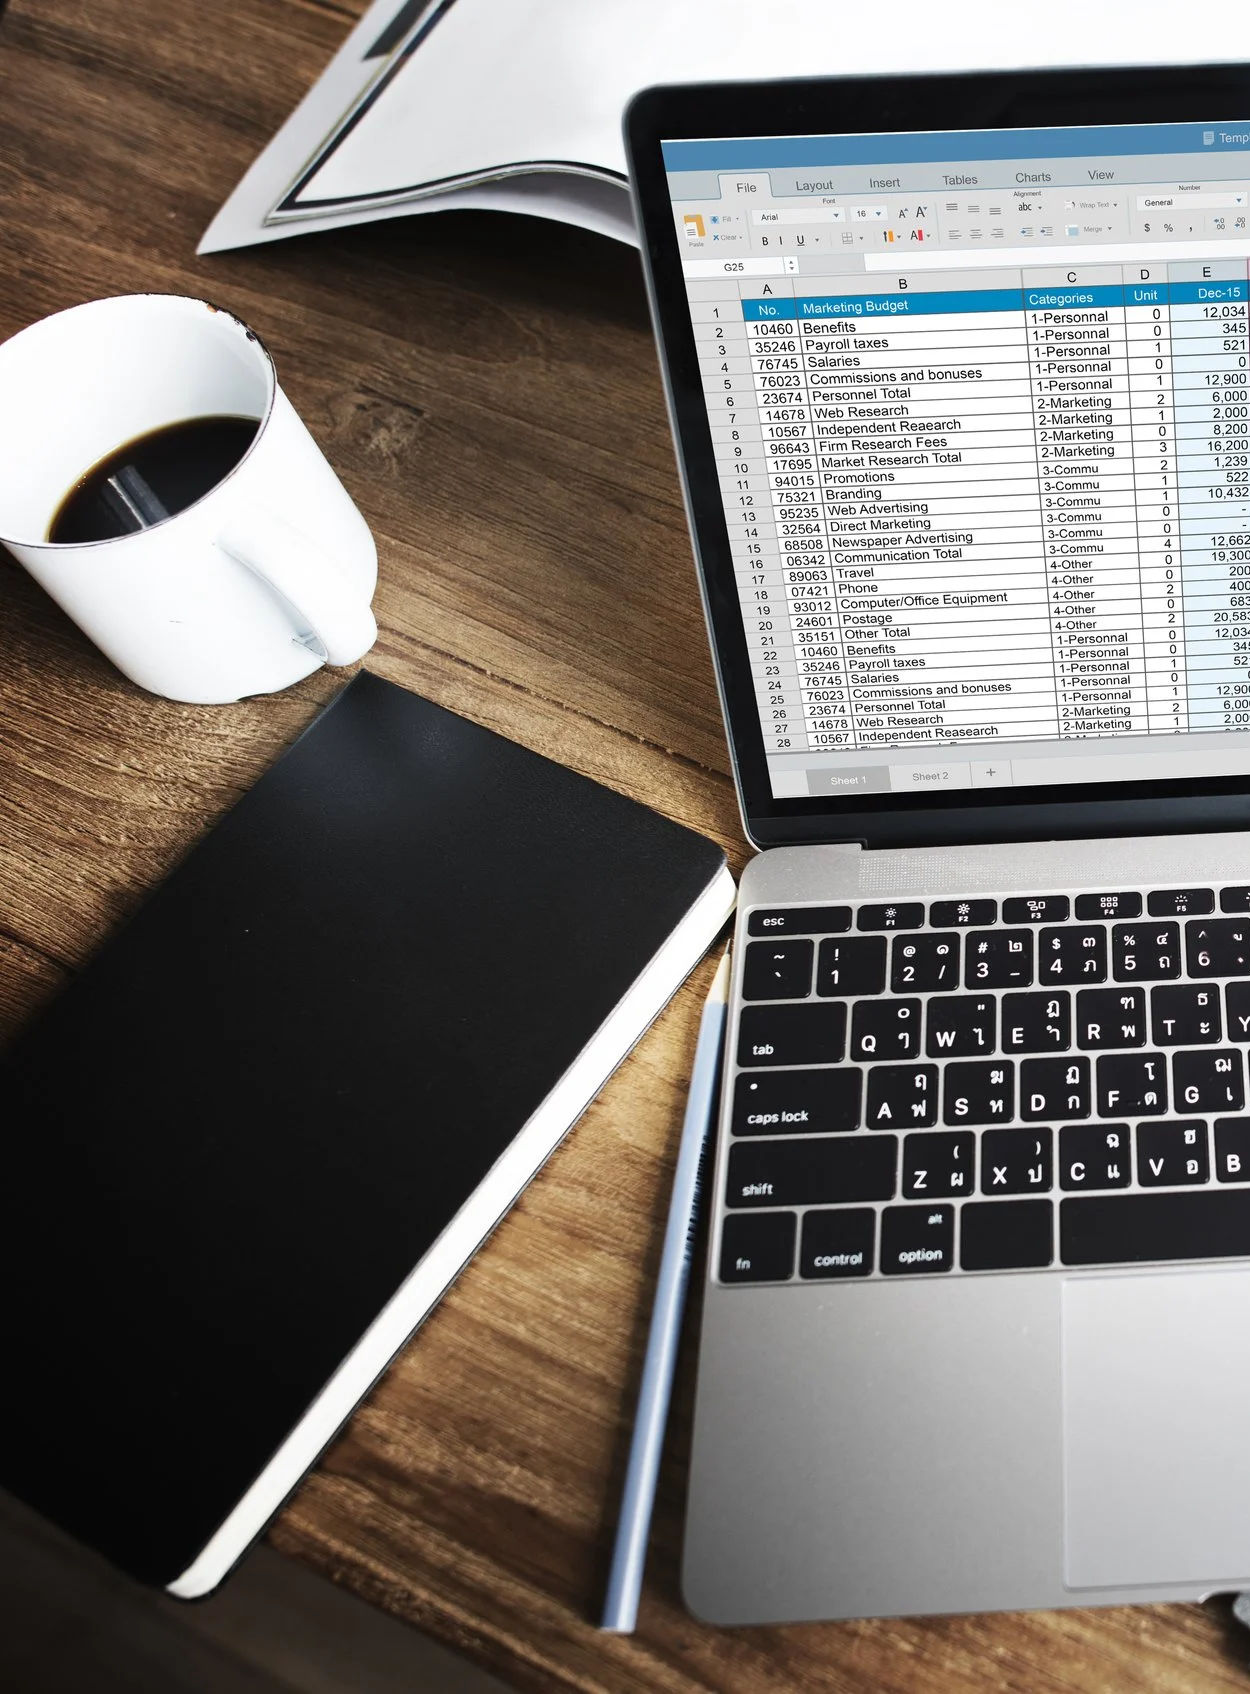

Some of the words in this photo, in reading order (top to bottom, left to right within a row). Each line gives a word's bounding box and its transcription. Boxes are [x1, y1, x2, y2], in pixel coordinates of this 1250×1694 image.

[943, 174, 978, 185] Tables
[1015, 172, 1051, 183] Charts
[1088, 170, 1114, 180] View
[737, 183, 757, 193] File
[796, 181, 833, 192] Layout
[869, 178, 900, 188] Insert
[1013, 190, 1041, 198] Alignment
[1018, 202, 1032, 212] abc
[1145, 199, 1173, 207] General
[761, 213, 778, 221] Arial
[857, 210, 866, 218] 16
[1083, 225, 1102, 234] Merge
[724, 263, 744, 272] G25
[1203, 267, 1211, 278] E
[1067, 271, 1077, 283] C
[763, 284, 772, 294] A
[899, 279, 908, 289] B
[1029, 292, 1094, 306] Categories
[1134, 289, 1158, 301] Unit
[1198, 287, 1240, 299] Dec-15
[758, 306, 780, 316] No.
[803, 302, 862, 314] Marketing
[866, 300, 908, 313] Budget
[1203, 305, 1246, 320] 12,034
[1032, 310, 1108, 325] 1-Personnal
[1153, 308, 1160, 320] 0
[754, 324, 793, 336] 10460
[804, 322, 856, 334] Benefits
[755, 341, 796, 353] 35246
[806, 339, 850, 354] Payroll
[854, 338, 889, 349] taxes
[758, 358, 798, 370] 76745
[808, 356, 860, 368] Salaries
[760, 376, 800, 388] 76023
[810, 371, 896, 386] Commissions
[900, 370, 925, 382] and
[928, 368, 982, 380] bonuses
[812, 389, 877, 402] Personnel
[881, 388, 911, 399] Total
[1037, 395, 1112, 411] 2-Marketing
[814, 408, 844, 419] Web
[848, 405, 909, 418] Research
[768, 426, 807, 438] 10567
[817, 422, 896, 437] Independent
[900, 419, 961, 432] Reaearch
[770, 442, 810, 454] 96643
[819, 441, 847, 452] Firm
[851, 438, 911, 450] Research
[916, 437, 947, 448] Fees
[773, 458, 812, 470] 17695
[821, 456, 865, 469] Market
[869, 454, 928, 466] Research
[932, 452, 962, 464] Total
[824, 471, 895, 484] Promotions
[826, 488, 882, 502] Branding
[828, 504, 857, 516] Web
[860, 502, 928, 516] Advertising
[830, 520, 866, 532] Direct
[870, 518, 930, 532] Marketing
[832, 536, 902, 551] Newspaper
[905, 532, 973, 546] Advertising
[1049, 542, 1104, 555] 3-Commu
[787, 555, 825, 566] 06342
[835, 551, 930, 564] Communication
[934, 548, 962, 559] Total
[1050, 558, 1092, 571] 4-Other
[836, 568, 874, 579] Travel
[839, 582, 878, 594] Phone
[840, 595, 939, 610] Computer/Office
[943, 592, 1008, 607] Equipment
[842, 612, 892, 627] Postage
[844, 628, 878, 639] Other
[881, 626, 910, 638] Total
[831, 774, 859, 786] Sheet
[863, 775, 867, 784] 1
[912, 771, 940, 782] Sheet
[941, 771, 948, 781] 2
[763, 916, 785, 927] esc
[1124, 955, 1136, 970] 5
[903, 966, 914, 982] 2
[1012, 1028, 1024, 1043] E
[1088, 1024, 1100, 1039] R
[861, 1035, 876, 1052] Q
[936, 1031, 956, 1047] W
[752, 1044, 774, 1055] tab
[1185, 1087, 1199, 1103] G
[878, 1102, 892, 1119] A
[955, 1098, 968, 1115] S
[747, 1113, 779, 1126] caps
[781, 1110, 809, 1122] lock
[1070, 1163, 1086, 1180] C
[914, 1171, 927, 1187] Z
[742, 1183, 773, 1196] shift
[928, 1213, 943, 1223] alt
[814, 1251, 862, 1266] control
[899, 1248, 943, 1263] option
[736, 1256, 751, 1271] fn
